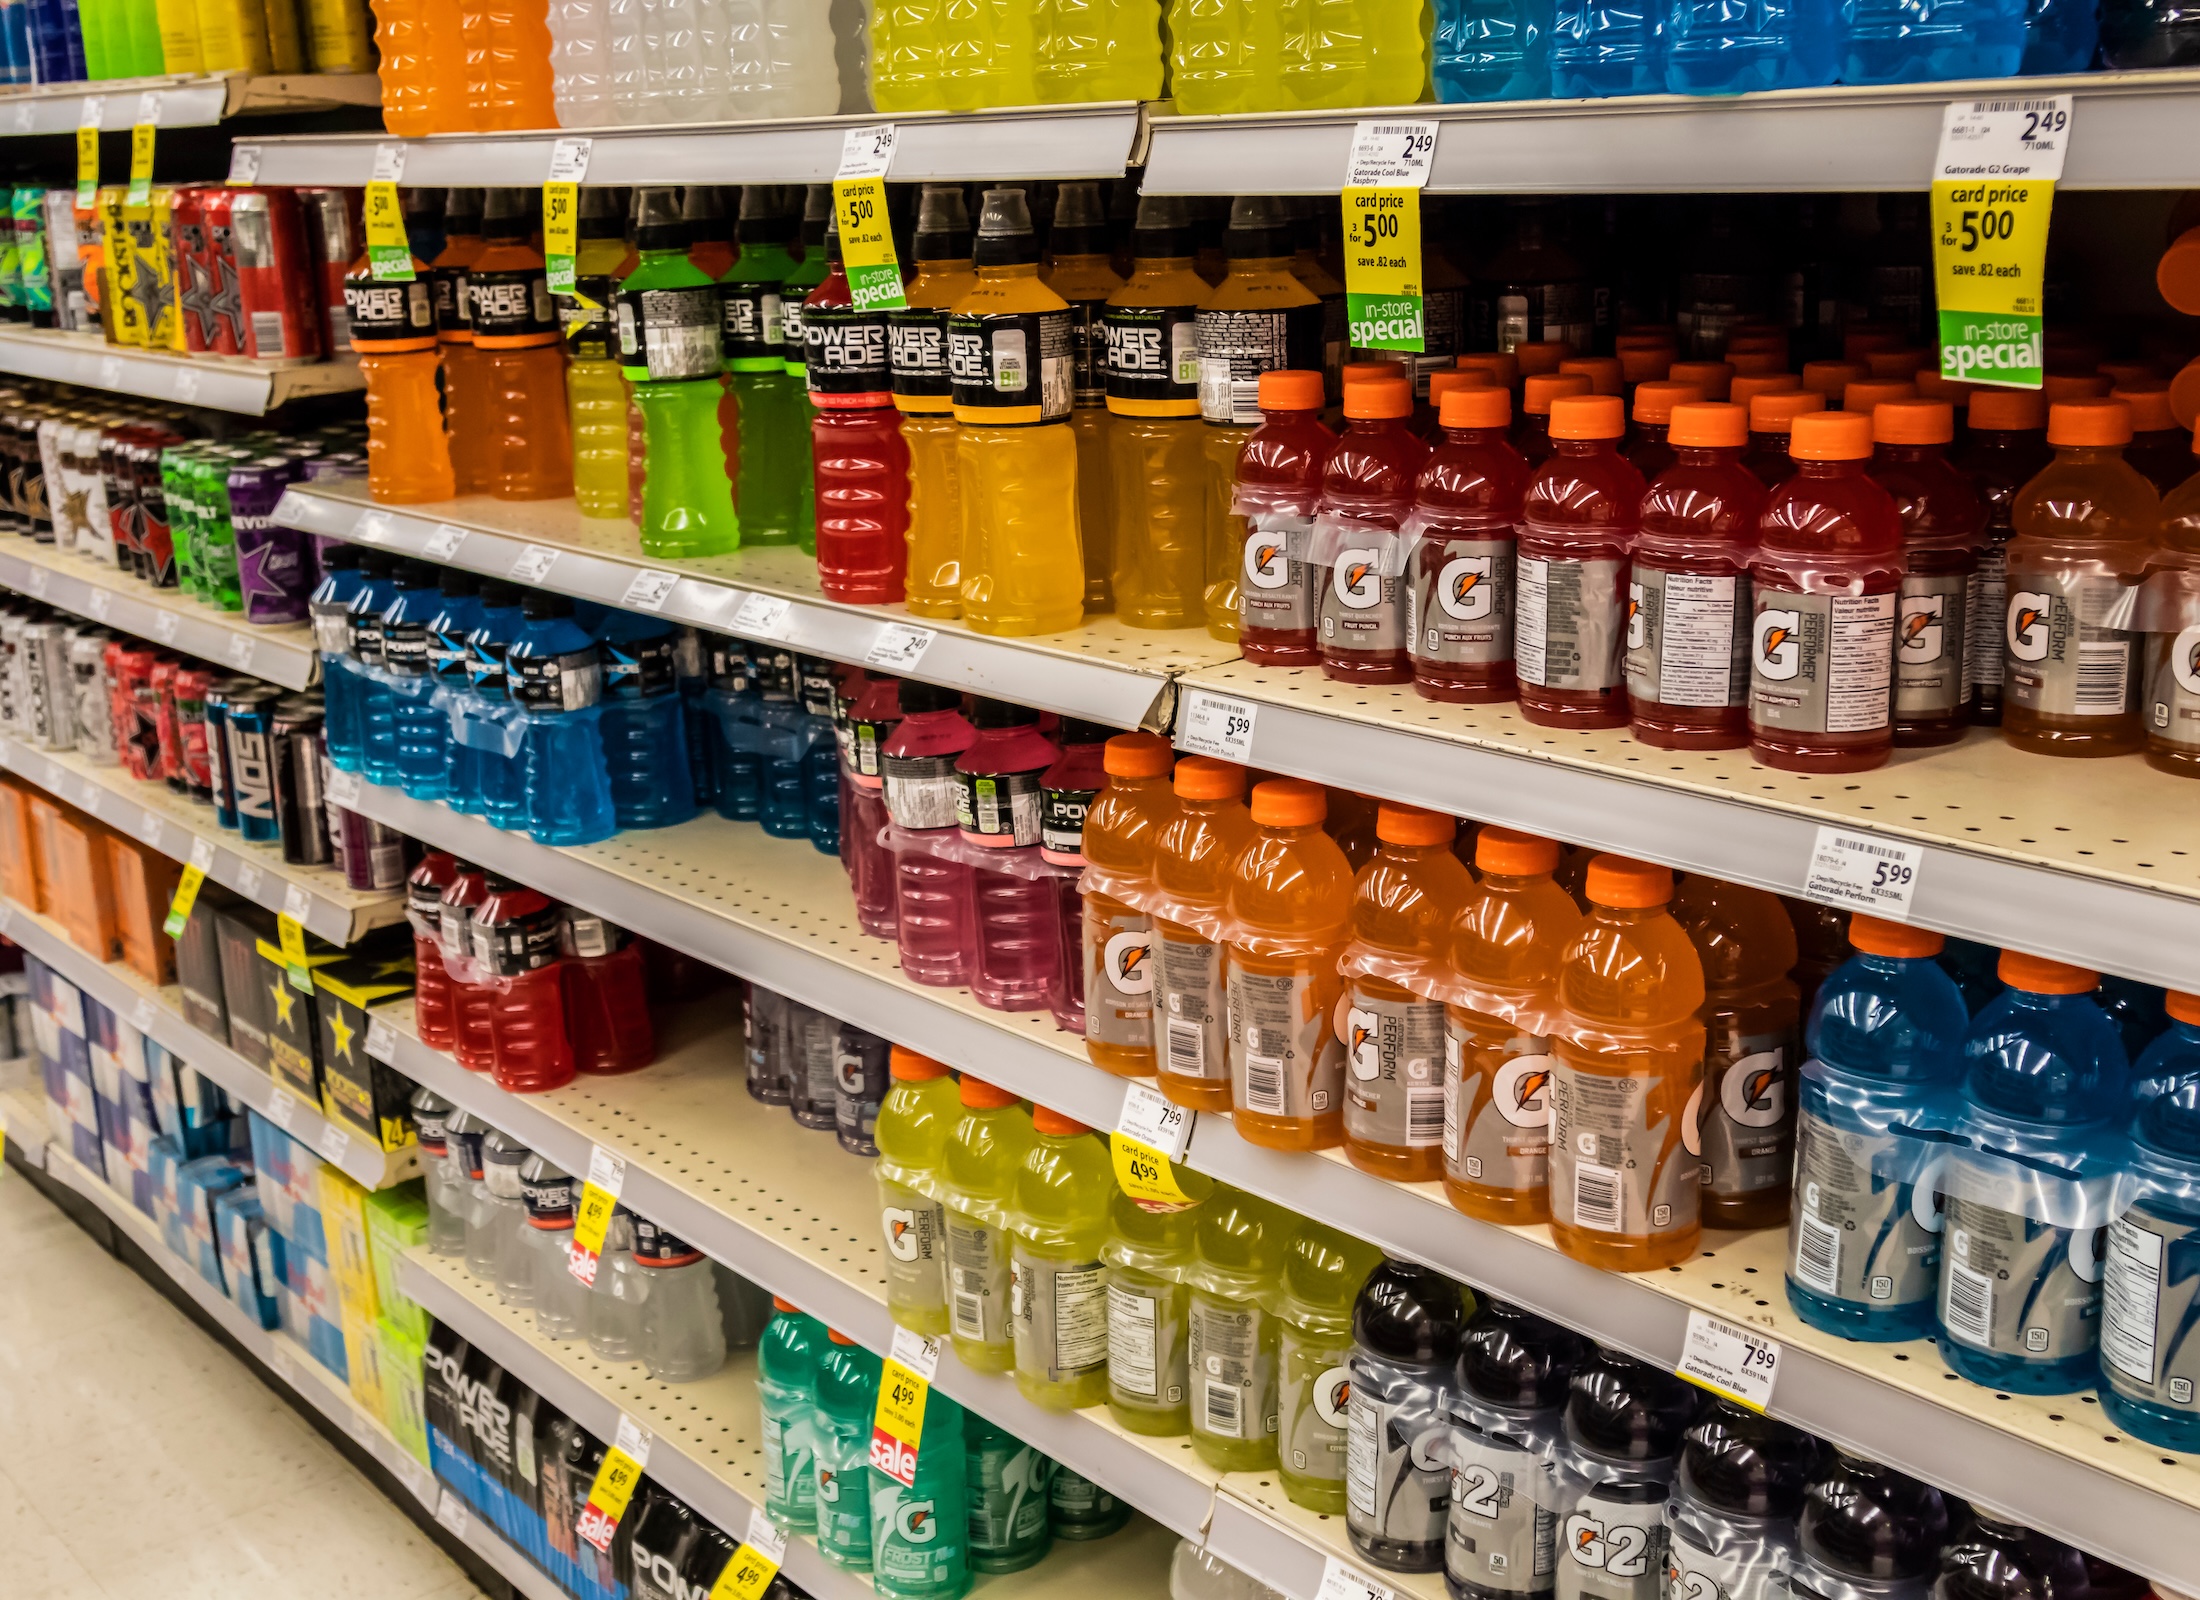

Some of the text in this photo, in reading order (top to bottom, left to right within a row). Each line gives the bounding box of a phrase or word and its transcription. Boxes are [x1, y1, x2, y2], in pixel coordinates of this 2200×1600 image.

[2021, 110, 2067, 142] 249
[873, 134, 892, 154] 249
[1402, 135, 1433, 159] 249
[2024, 141, 2055, 151] 710ML
[1354, 168, 1409, 177] Gatorade Cool Blue
[1404, 159, 1424, 168] 710ML
[1945, 165, 2030, 176] Gatorade G2 Grape
[843, 184, 874, 198] card price
[1352, 176, 1378, 185] Raspbrry
[1355, 193, 1404, 211] card price
[1951, 185, 2028, 206] card price
[551, 198, 567, 221] 500
[841, 200, 873, 229] for 500
[1349, 213, 1398, 248] for 500
[1352, 223, 1357, 232] 3
[1941, 209, 2014, 252] for 500
[1945, 222, 1952, 232] 3
[849, 235, 860, 244] save
[870, 233, 883, 242] each
[371, 254, 412, 278] special
[1357, 256, 1407, 268] save .82 each
[1952, 263, 2021, 278] save .82 each
[547, 264, 575, 292] special
[860, 269, 893, 286] in-store
[852, 274, 904, 310] special
[1365, 301, 1412, 318] in-store
[803, 325, 885, 346] POWER
[1351, 310, 1423, 347] special
[1964, 322, 2029, 341] in-store
[824, 345, 885, 366] ADE
[893, 346, 940, 368] ADE
[1108, 347, 1162, 371] ADE
[1944, 332, 2042, 378] special
[1244, 530, 1290, 590] G
[1333, 548, 1382, 610] G
[1437, 555, 1493, 621] G
[1667, 584, 1685, 592] Valeur
[1668, 576, 1693, 584] Nutrition
[1645, 586, 1654, 653] PERFORMER
[1901, 594, 1944, 665] G
[2006, 591, 2052, 662] G
[2051, 595, 2068, 661] PERFORM
[904, 636, 928, 652] 249
[1472, 634, 1492, 642] FRUITS
[1817, 613, 1826, 655] GATORADE
[1752, 608, 1801, 682] G
[1802, 612, 1818, 681] PERFORMER
[1226, 716, 1250, 736] 599
[1186, 741, 1235, 758] Gatorade Fruit Punch
[1872, 861, 1912, 887] 599
[1806, 889, 1834, 903] Orange
[1809, 881, 1876, 904] Gatorade Perform
[1871, 887, 1903, 901] 6X355ML
[1104, 930, 1151, 995] G
[1125, 1011, 1148, 1019] ORANGE
[1229, 980, 1242, 1045] PERFORM
[1347, 1006, 1380, 1082] G
[1383, 1015, 1398, 1081] PERFORM
[837, 1054, 865, 1095] G
[1407, 1058, 1428, 1079] G
[1314, 1092, 1326, 1101] 150
[1492, 1054, 1550, 1129] G
[1721, 1047, 1785, 1128] G
[1160, 1107, 1181, 1125] 799
[1557, 1079, 1570, 1153] PERFORM
[1121, 1125, 1157, 1145] Gatorade Orange
[1576, 1132, 1597, 1156] G
[1122, 1144, 1159, 1165] card price
[1519, 1147, 1546, 1155] ORANGE
[1130, 1160, 1158, 1181] 499
[1468, 1159, 1480, 1169] 150
[587, 1201, 602, 1220] 499
[1657, 1206, 1668, 1216] 150
[882, 1206, 919, 1263] G
[918, 1209, 933, 1261] PERFORM
[1953, 1229, 1969, 1257] G
[569, 1249, 597, 1284] sale
[1022, 1265, 1033, 1323] PERFORMER
[1874, 1278, 1889, 1290] 150
[1191, 1312, 1200, 1373] PERFORM
[2030, 1331, 2046, 1342] 150
[921, 1340, 938, 1357] 799
[1743, 1343, 1775, 1369] 799
[892, 1368, 919, 1390] card price
[1685, 1362, 1748, 1394] Gatorade Cool Blue
[1741, 1367, 1769, 1384] 6X591ML
[2173, 1380, 2189, 1392] 150
[892, 1384, 914, 1405] 499
[870, 1438, 916, 1480] sale
[609, 1468, 628, 1486] 499
[576, 1510, 614, 1546] sale
[894, 1499, 937, 1544] G
[1565, 1514, 1649, 1578] G2
[884, 1549, 932, 1566] FROST
[1494, 1556, 1504, 1566] 50
[736, 1566, 760, 1586] 499
